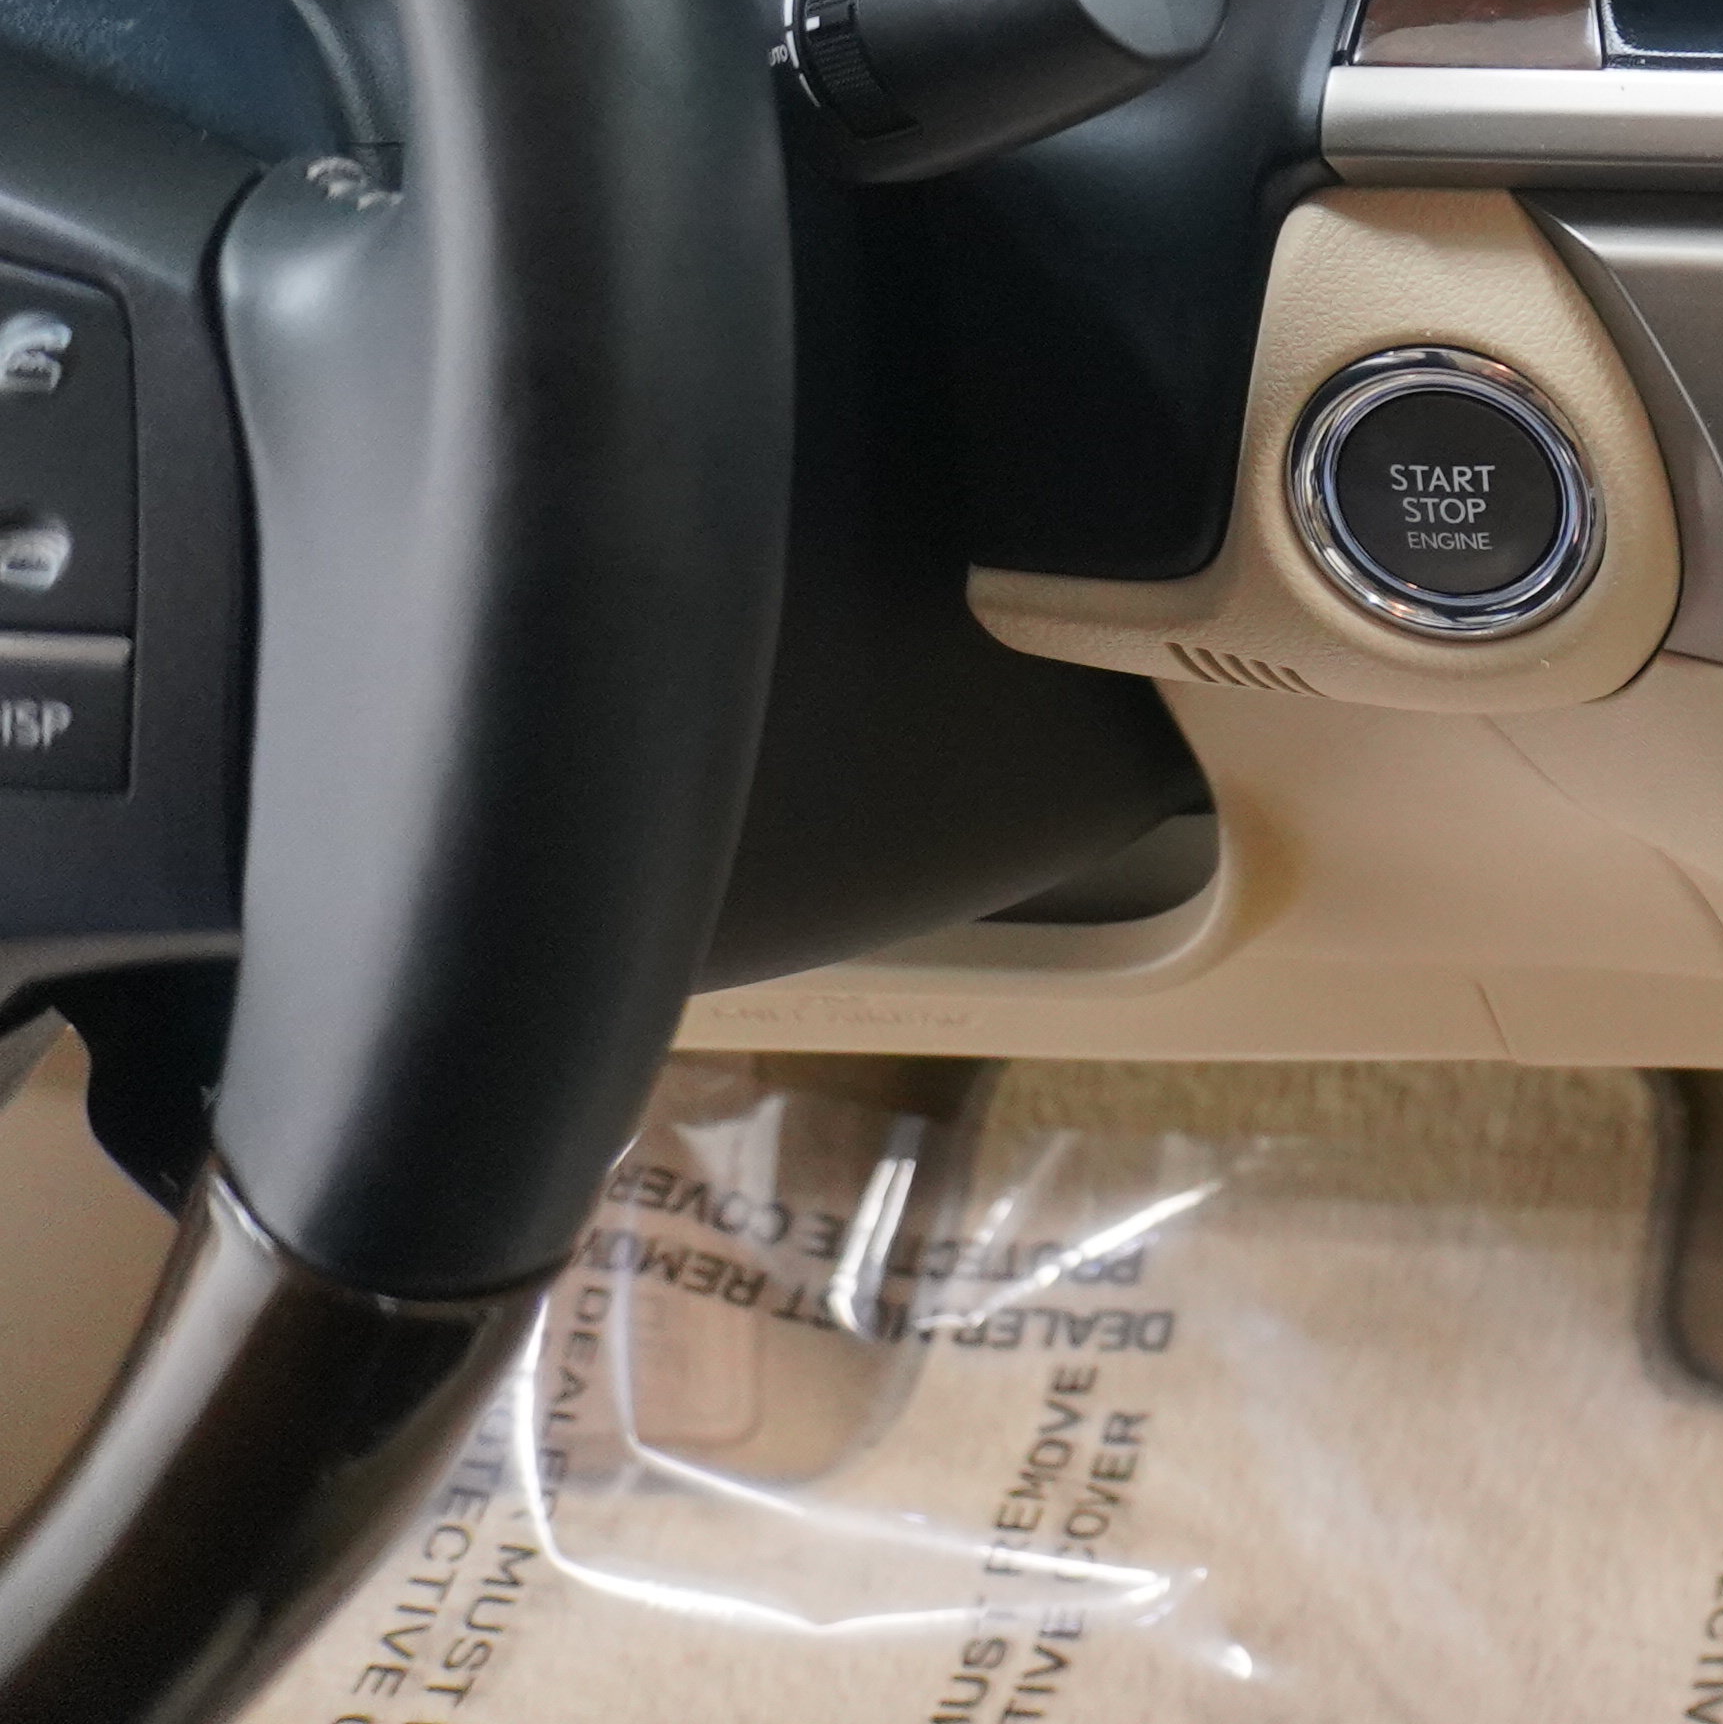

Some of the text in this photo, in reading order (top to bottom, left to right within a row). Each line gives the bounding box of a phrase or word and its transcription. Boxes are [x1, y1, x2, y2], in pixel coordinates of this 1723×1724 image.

[1389, 463, 1495, 492] START
[1402, 498, 1487, 524] STOP
[1407, 531, 1493, 551] ENGINE
[425, 1542, 538, 1707] MUST
